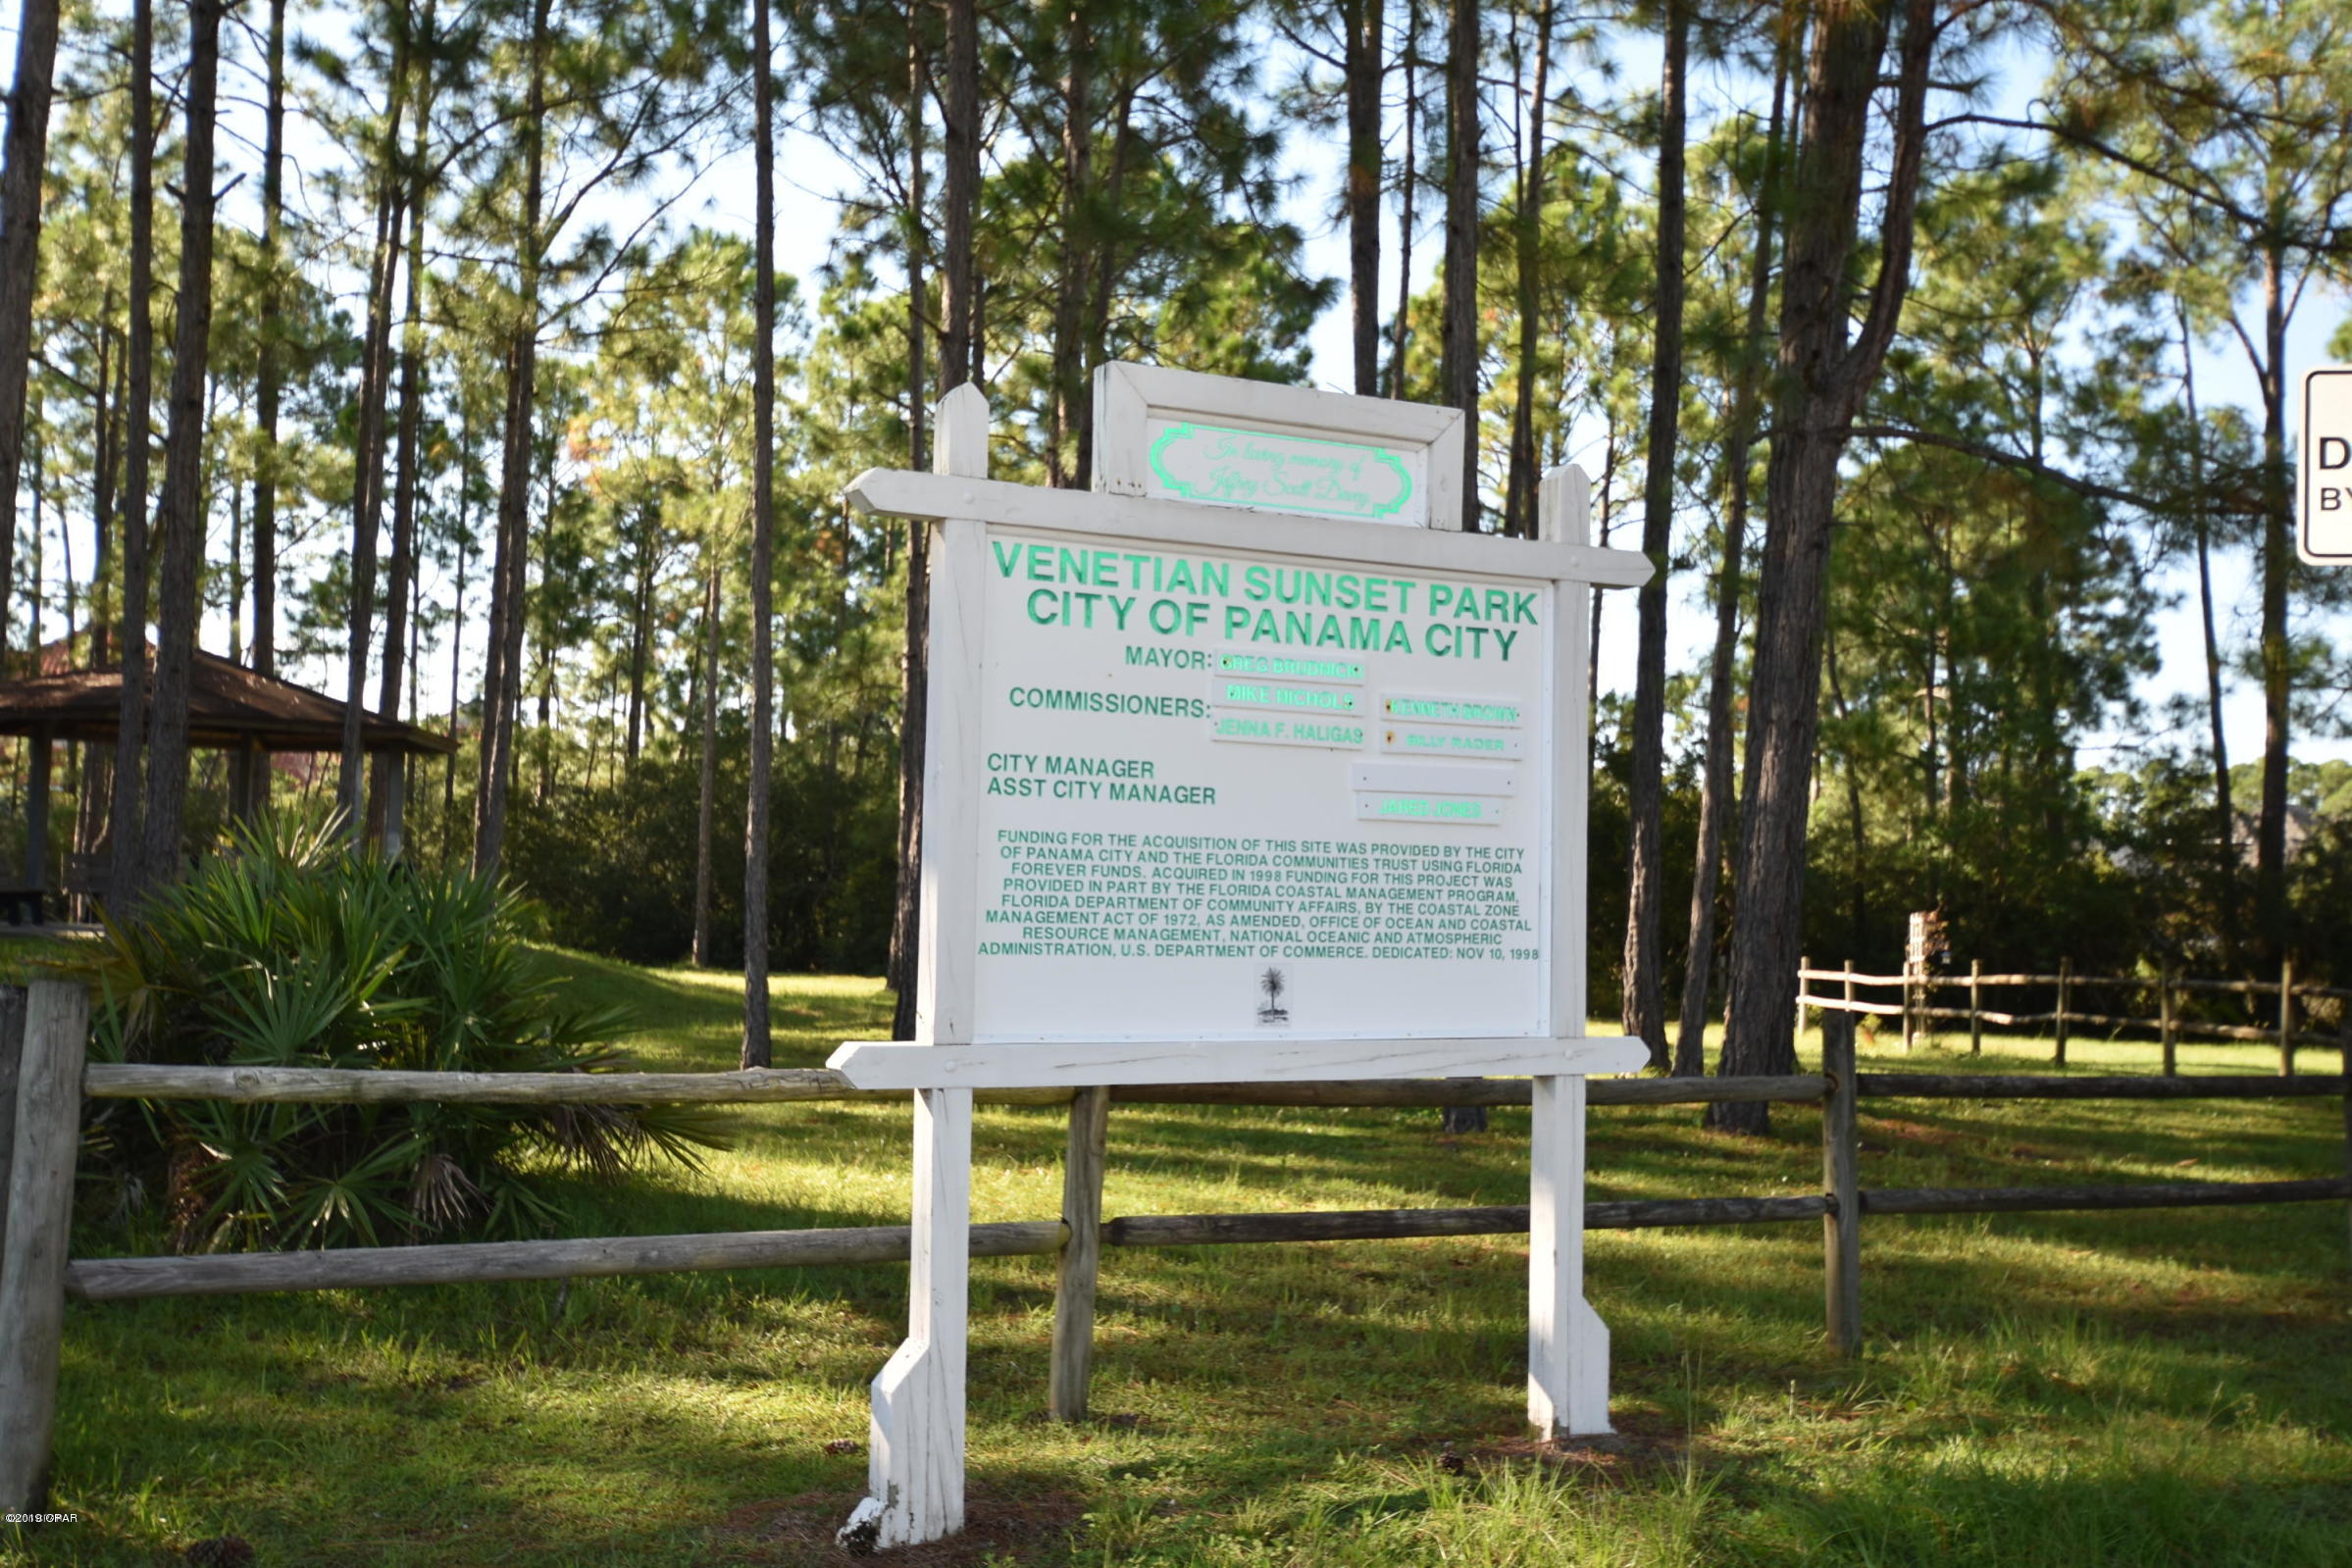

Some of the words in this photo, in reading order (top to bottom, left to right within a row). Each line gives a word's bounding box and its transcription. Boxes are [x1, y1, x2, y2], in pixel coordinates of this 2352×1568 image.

[2320, 436, 2352, 470] D
[993, 541, 1230, 597] VENETIAN
[1244, 566, 1416, 615] SUNSET
[1430, 584, 1538, 628] PARK
[1027, 588, 1136, 631] CITY
[1150, 599, 1210, 635] OF
[1225, 604, 1412, 654] PANAMA
[1425, 624, 1517, 661] CITY
[1125, 645, 1211, 670] MAYOR:
[1219, 653, 1270, 675] GREG
[1009, 687, 1210, 718] COMMISSIONERS:
[1225, 683, 1272, 704] MIKE
[1275, 687, 1355, 711] NICHOLS
[1390, 697, 1460, 719] KENNETH
[1216, 718, 1271, 737] JENNA
[1274, 723, 1290, 738] F.
[1293, 724, 1364, 744] HALIGAS
[1406, 734, 1447, 747] BILLY
[988, 753, 1038, 773] CITY
[1046, 756, 1153, 779] MANAGER
[988, 777, 1047, 796] ASST
[1053, 780, 1102, 799] CITY
[1109, 783, 1215, 804] MANAGER
[997, 830, 1067, 845] FUNDING
[1072, 833, 1102, 845] FOR
[1108, 834, 1137, 847] THE
[1143, 835, 1237, 850] ACQUISITION
[1242, 839, 1260, 851] OF
[1265, 840, 1297, 852] THIS
[1302, 840, 1331, 853] SITE
[1336, 842, 1366, 854] WAS
[1371, 843, 1440, 857] PROVIDED
[1444, 846, 1460, 857] BY
[1465, 847, 1491, 859] THE
[1495, 847, 1524, 860] CITY
[1000, 845, 1022, 859] OF
[1027, 846, 1094, 861] PANAMA
[1099, 849, 1133, 862] CITY
[1138, 850, 1168, 863] AND
[1173, 851, 1202, 865] THE
[1206, 853, 1268, 866] FLORIDA
[1272, 855, 1368, 870] COMMUNITIES
[1373, 858, 1417, 871] TRUST
[1422, 860, 1462, 872] USING
[1466, 861, 1521, 874] FLORIDA
[1012, 862, 1086, 877] FOREVER
[1151, 867, 1228, 881] ACQUIRED
[1232, 869, 1245, 881] IN
[1251, 870, 1282, 882] 1998
[1286, 870, 1348, 884] FUNDING
[1352, 873, 1379, 885] FOR
[1383, 873, 1413, 885] THIS
[1417, 874, 1479, 886] PROJECT
[1483, 877, 1512, 888] WAS
[1004, 878, 1084, 892] PROVIDED
[1089, 881, 1101, 892] IN
[1107, 881, 1147, 893] PART
[1151, 882, 1171, 894] BY
[1177, 883, 1204, 895] THE
[1209, 884, 1271, 896] FLORIDA
[1276, 885, 1342, 898] COASTAL
[1346, 887, 1443, 900] MANAGEMENT
[1448, 889, 1518, 902] PROGRAM,
[1001, 894, 1069, 908] FLORIDA
[1075, 895, 1178, 910] DEPARTMENT
[1183, 898, 1202, 910] OF
[1207, 899, 1294, 912] COMMUNITY
[1298, 901, 1360, 914] AFFAIRS,
[1365, 902, 1383, 914] BY
[1388, 902, 1413, 915] THE
[1417, 903, 1481, 916] COASTAL
[1485, 905, 1519, 916] ZONE
[986, 910, 1099, 924] MANAGEMENT
[1103, 912, 1134, 925] ACT
[1139, 913, 1158, 925] OF
[1164, 914, 1200, 926] 1972,
[1206, 914, 1225, 926] AS
[1230, 914, 1304, 928] AMENDED,
[1309, 916, 1358, 928] OFFICE
[1363, 917, 1381, 929] OF
[1385, 917, 1433, 929] OCEAN
[1438, 919, 1466, 930] AND
[1470, 919, 1531, 931] COASTAL
[1023, 927, 1108, 940] RESOURCE
[1114, 928, 1225, 942] MANAGEMENT,
[1230, 930, 1303, 942] NATIONAL
[1307, 931, 1369, 943] OCEANIC
[1374, 932, 1403, 943] AND
[1406, 933, 1502, 944] ATMOSPHERIC
[1121, 943, 1150, 956] U.S.
[1154, 944, 1254, 957] DEPARTMENT
[1259, 945, 1278, 957] OF
[1372, 946, 1452, 959] DEDICATED:
[1457, 947, 1484, 959] NOV
[1489, 948, 1505, 960] 10,
[1510, 949, 1540, 960] 1998
